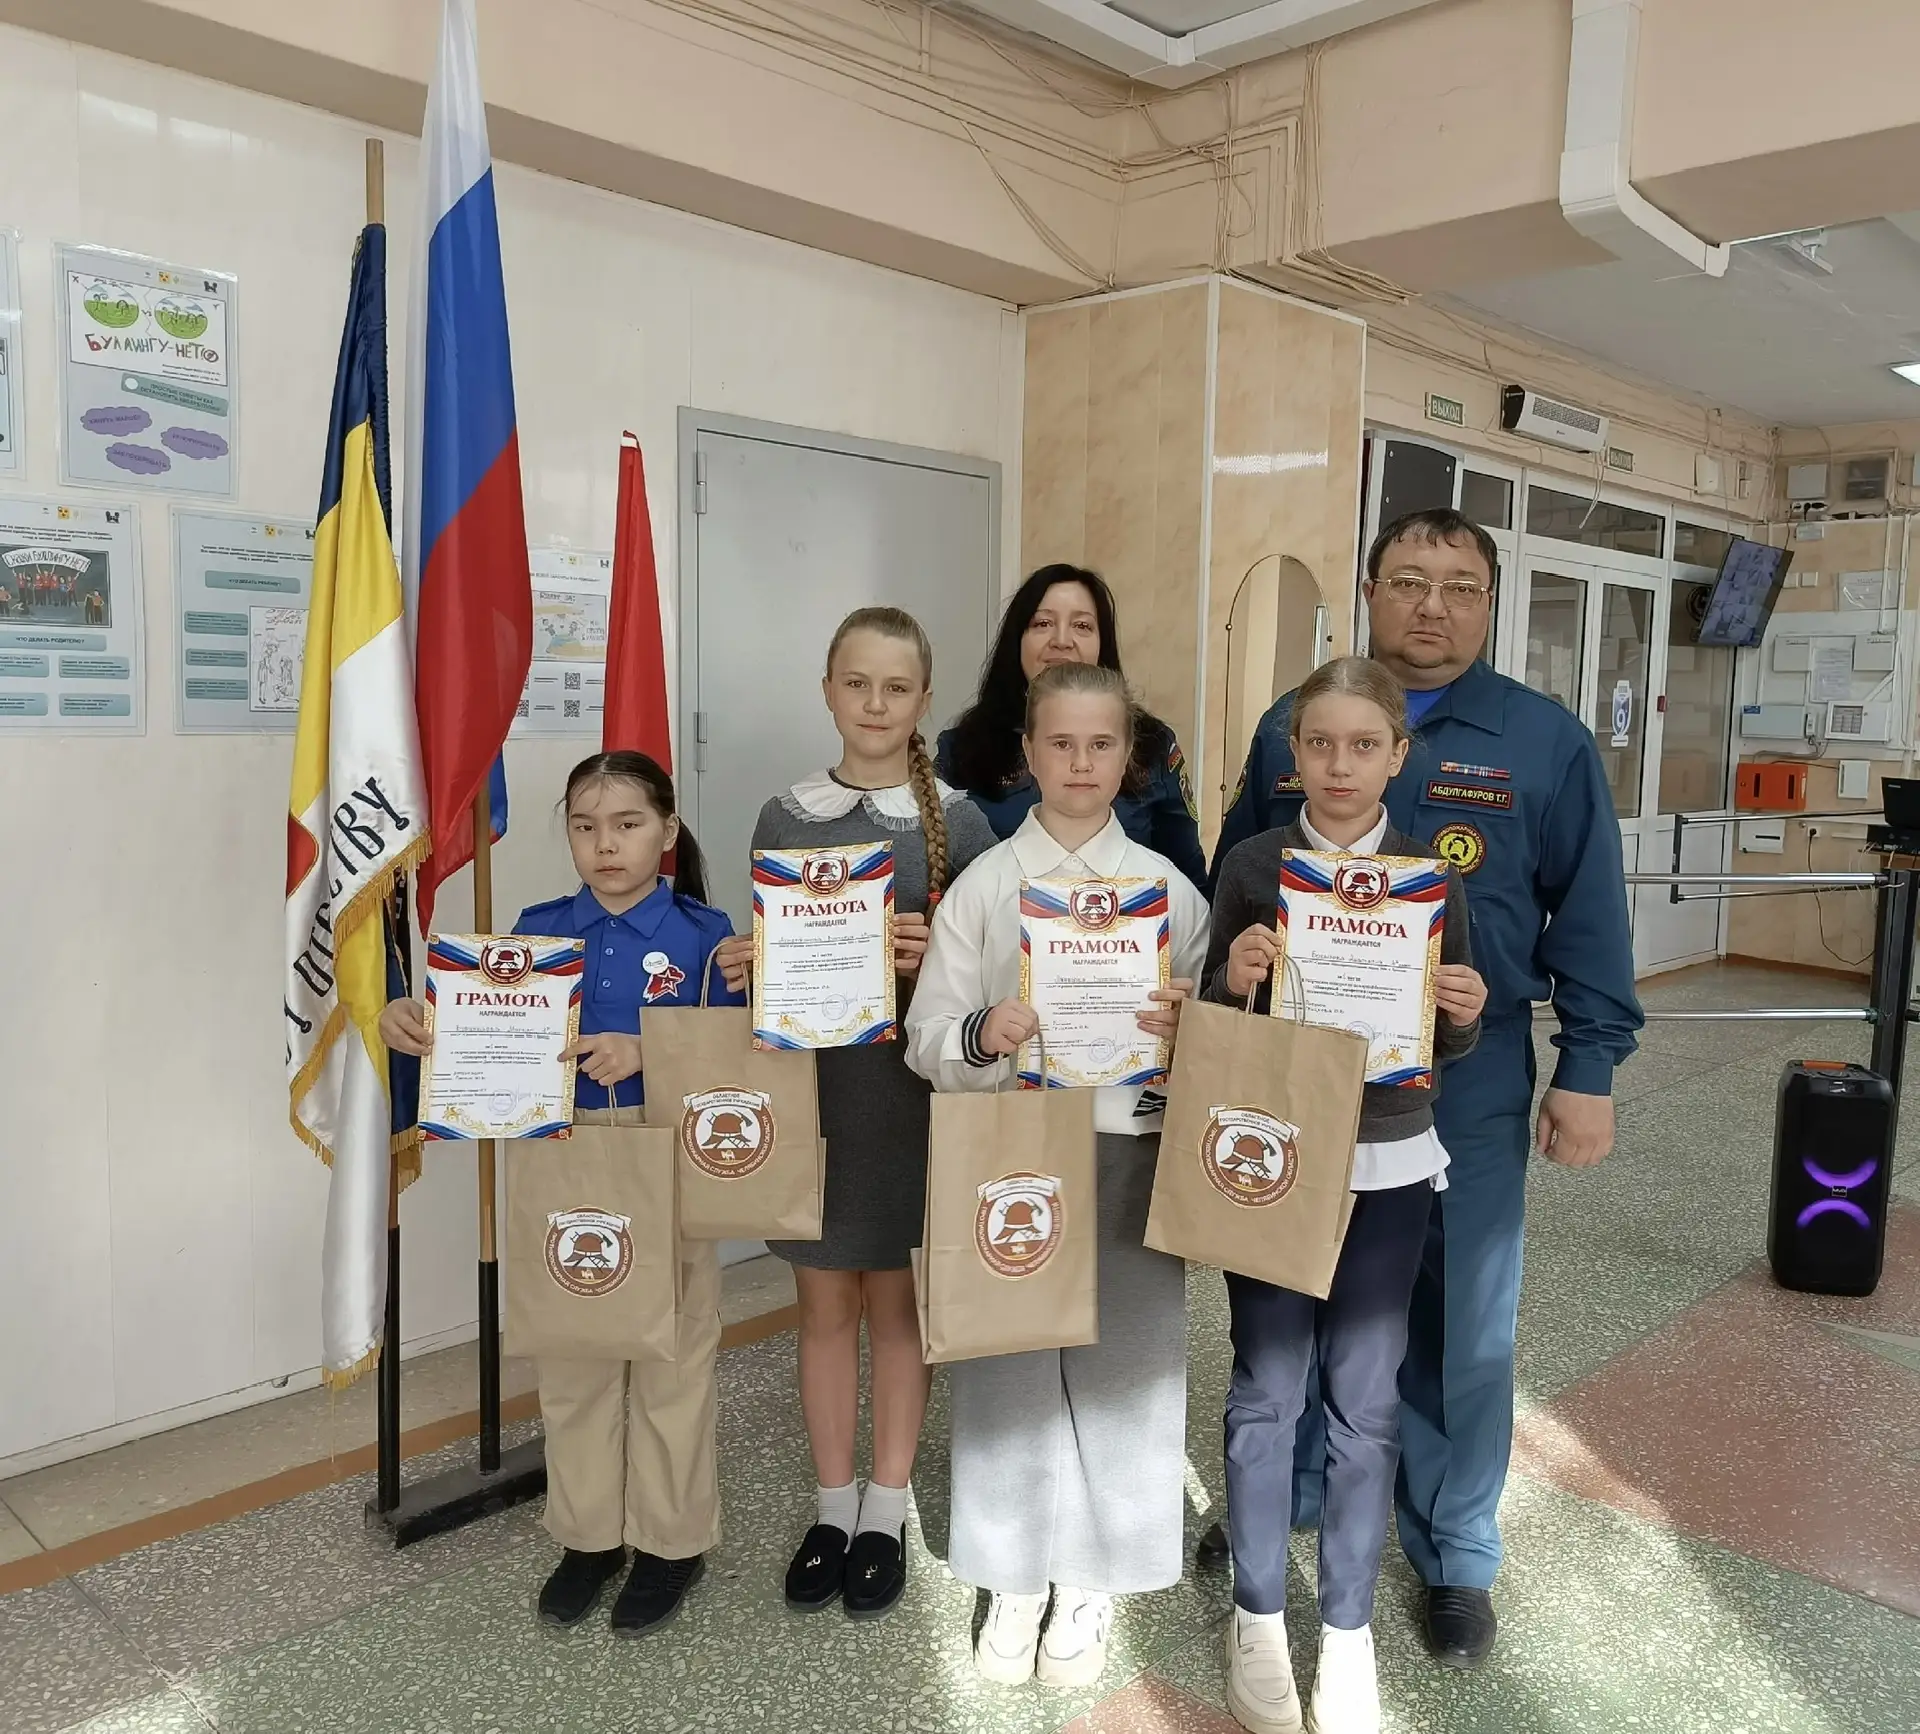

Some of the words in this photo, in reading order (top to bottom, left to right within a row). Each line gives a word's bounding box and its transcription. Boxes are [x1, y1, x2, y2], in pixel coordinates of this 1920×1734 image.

[1432, 400, 1460, 421] ВЫХОД
[1431, 785, 1495, 801] АБДУЛГАФУРОВ
[1496, 794, 1508, 803] Т.Г.
[782, 900, 868, 917] ГРАМОТА
[1307, 915, 1408, 938] ГРАМОТА
[1048, 939, 1141, 953] ГРАМОТА
[1331, 937, 1382, 948] НАГРАЖДАЕТСЯ
[1072, 958, 1118, 966] НАГРАЖДАЕТСЯ
[455, 992, 551, 1008] ГРАМОТА
[479, 1010, 527, 1018] НАГРАЖДАЕТСЯ
[1241, 1112, 1270, 1124] ОБЛАСТНОЕ
[709, 1166, 735, 1175] СЛУЖБА
[1224, 1187, 1249, 1202] СЛУЖБА
